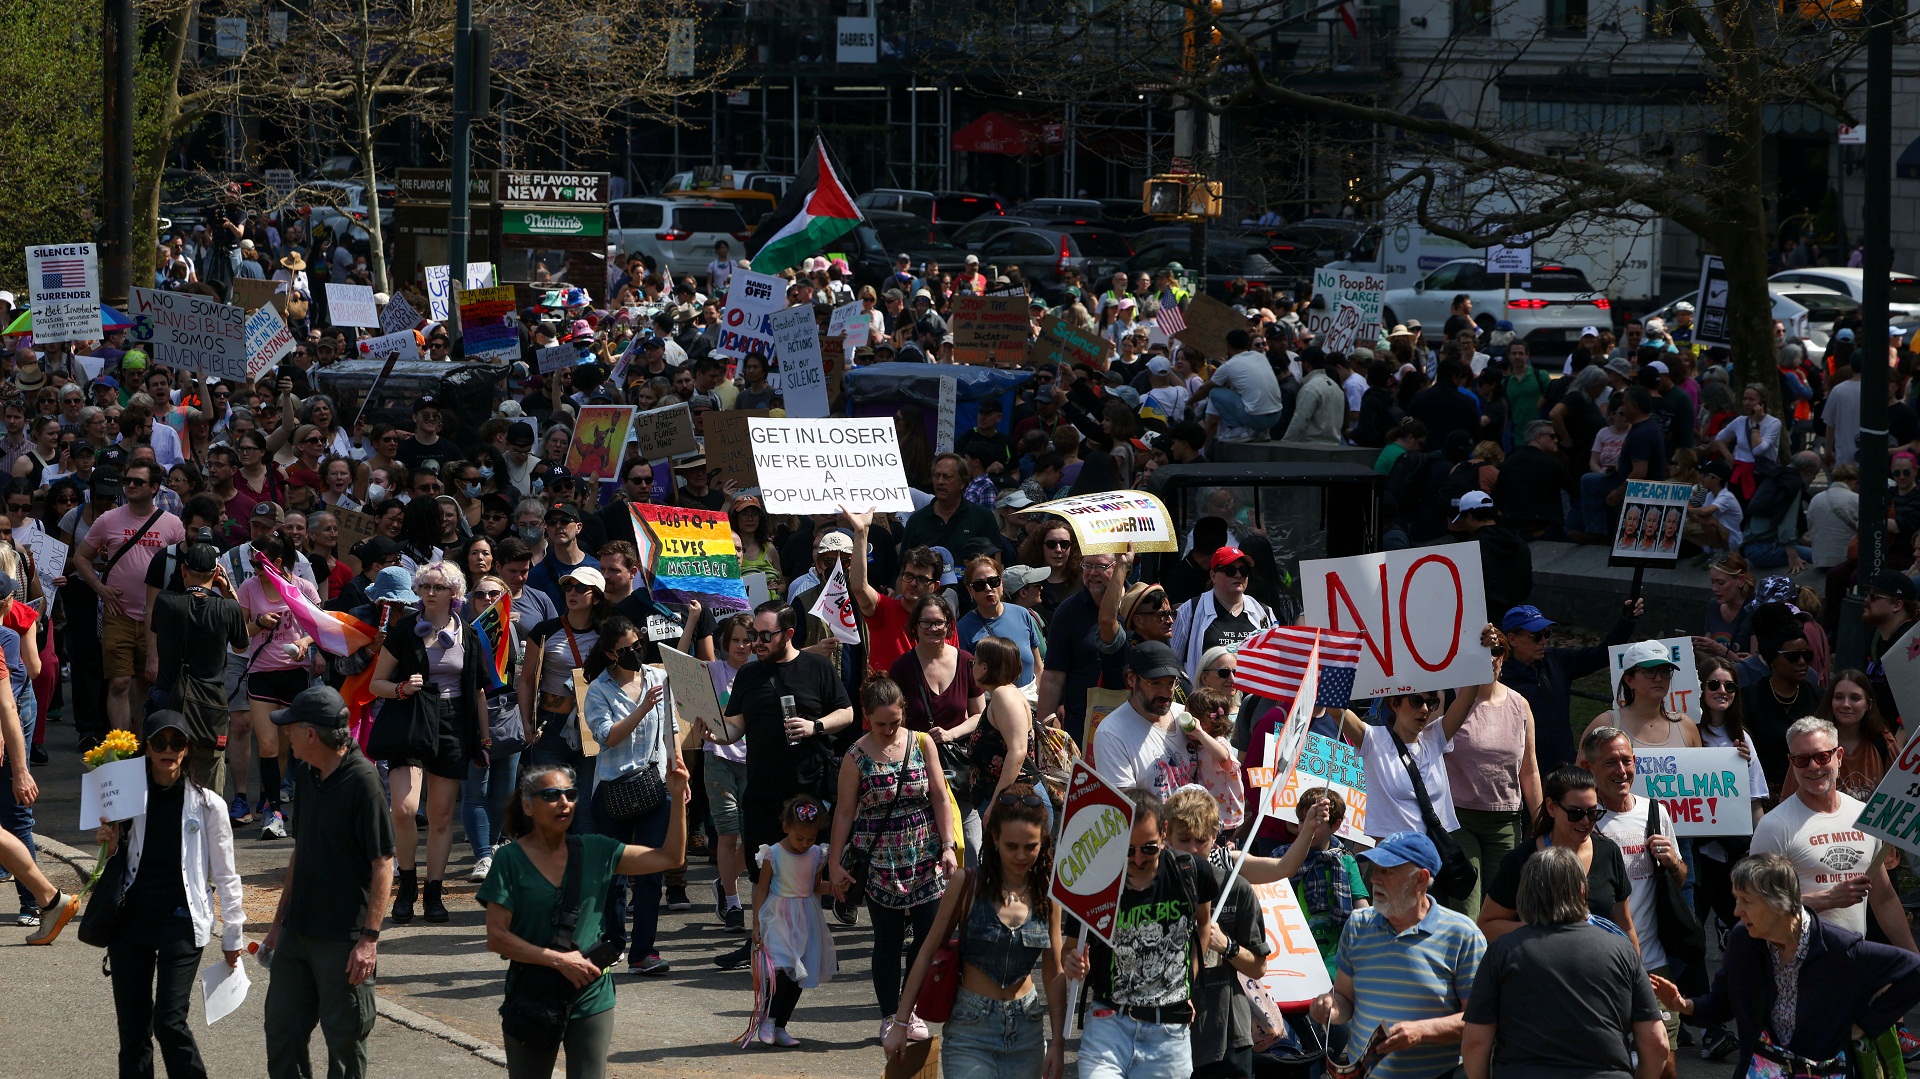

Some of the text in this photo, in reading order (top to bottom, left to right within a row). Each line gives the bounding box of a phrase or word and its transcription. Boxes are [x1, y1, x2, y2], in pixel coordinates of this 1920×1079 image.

[840, 32, 874, 47] GABRIEL'S
[401, 179, 412, 189] THE
[413, 179, 436, 190] FLAVOR
[436, 180, 444, 189] OF
[508, 174, 598, 186] THE FLAVOR OF
[508, 186, 548, 200] NEW
[524, 213, 583, 230] Nathan's
[34, 246, 90, 258] SILENCE IS
[746, 280, 772, 290] HANDS
[1365, 276, 1384, 291] BAG
[36, 291, 90, 301] SURRENDER
[744, 286, 771, 300] OFF!
[1345, 290, 1380, 302] LARGE
[152, 294, 242, 324] NO SOMOS
[960, 298, 1008, 310] STOP THE
[154, 308, 243, 340] INVISIBLES
[728, 308, 774, 336] OUR
[772, 312, 810, 332] Greatest Threat
[954, 312, 978, 321] MASS
[1333, 304, 1360, 330] TURD
[254, 317, 282, 348] IS IN THE
[958, 322, 973, 330] with
[172, 330, 226, 354] SOMOS
[719, 330, 775, 360] DEMOCRACY
[788, 337, 812, 354] ACTIONS
[1053, 322, 1100, 356] Science
[248, 326, 293, 376] RESISTANCE
[154, 342, 246, 378] INVENCIBLES
[783, 358, 810, 372] But our
[788, 367, 820, 390] SILENCE
[638, 408, 686, 427] LET FREEDOM
[714, 416, 742, 434] LIFT
[642, 435, 650, 443] NO
[720, 433, 742, 445] ALL
[752, 426, 894, 444] GET IN LOSER!
[720, 448, 746, 464] SINK
[754, 453, 898, 468] WE'RE BUILDING
[824, 470, 836, 483] A
[762, 486, 908, 502] POPULAR FRONT
[1626, 482, 1692, 500] IMPEACH NOW
[1062, 498, 1157, 515] LOVE MUST BE
[658, 512, 718, 530] LGBTQ+
[1089, 516, 1156, 534] LOUDER!!!!
[122, 536, 162, 548] AATHY
[124, 529, 160, 538] REIST
[664, 539, 706, 556] LIVES
[1874, 530, 1882, 576] C5902
[668, 560, 728, 578] MATTER!
[1325, 554, 1464, 677] NO
[656, 626, 676, 635] ELON
[676, 691, 712, 714] CIRCUS
[1293, 752, 1366, 792] EOPLE
[1635, 756, 1677, 775] RING
[1250, 770, 1297, 788] HAE
[1644, 770, 1740, 798] KILMAR
[1658, 798, 1718, 824] OME!
[1809, 831, 1865, 846] GET MITCH
[1059, 807, 1128, 888] CAPITALISM
[1622, 844, 1645, 855] TRANS
[1815, 873, 1842, 884] OR DIE
